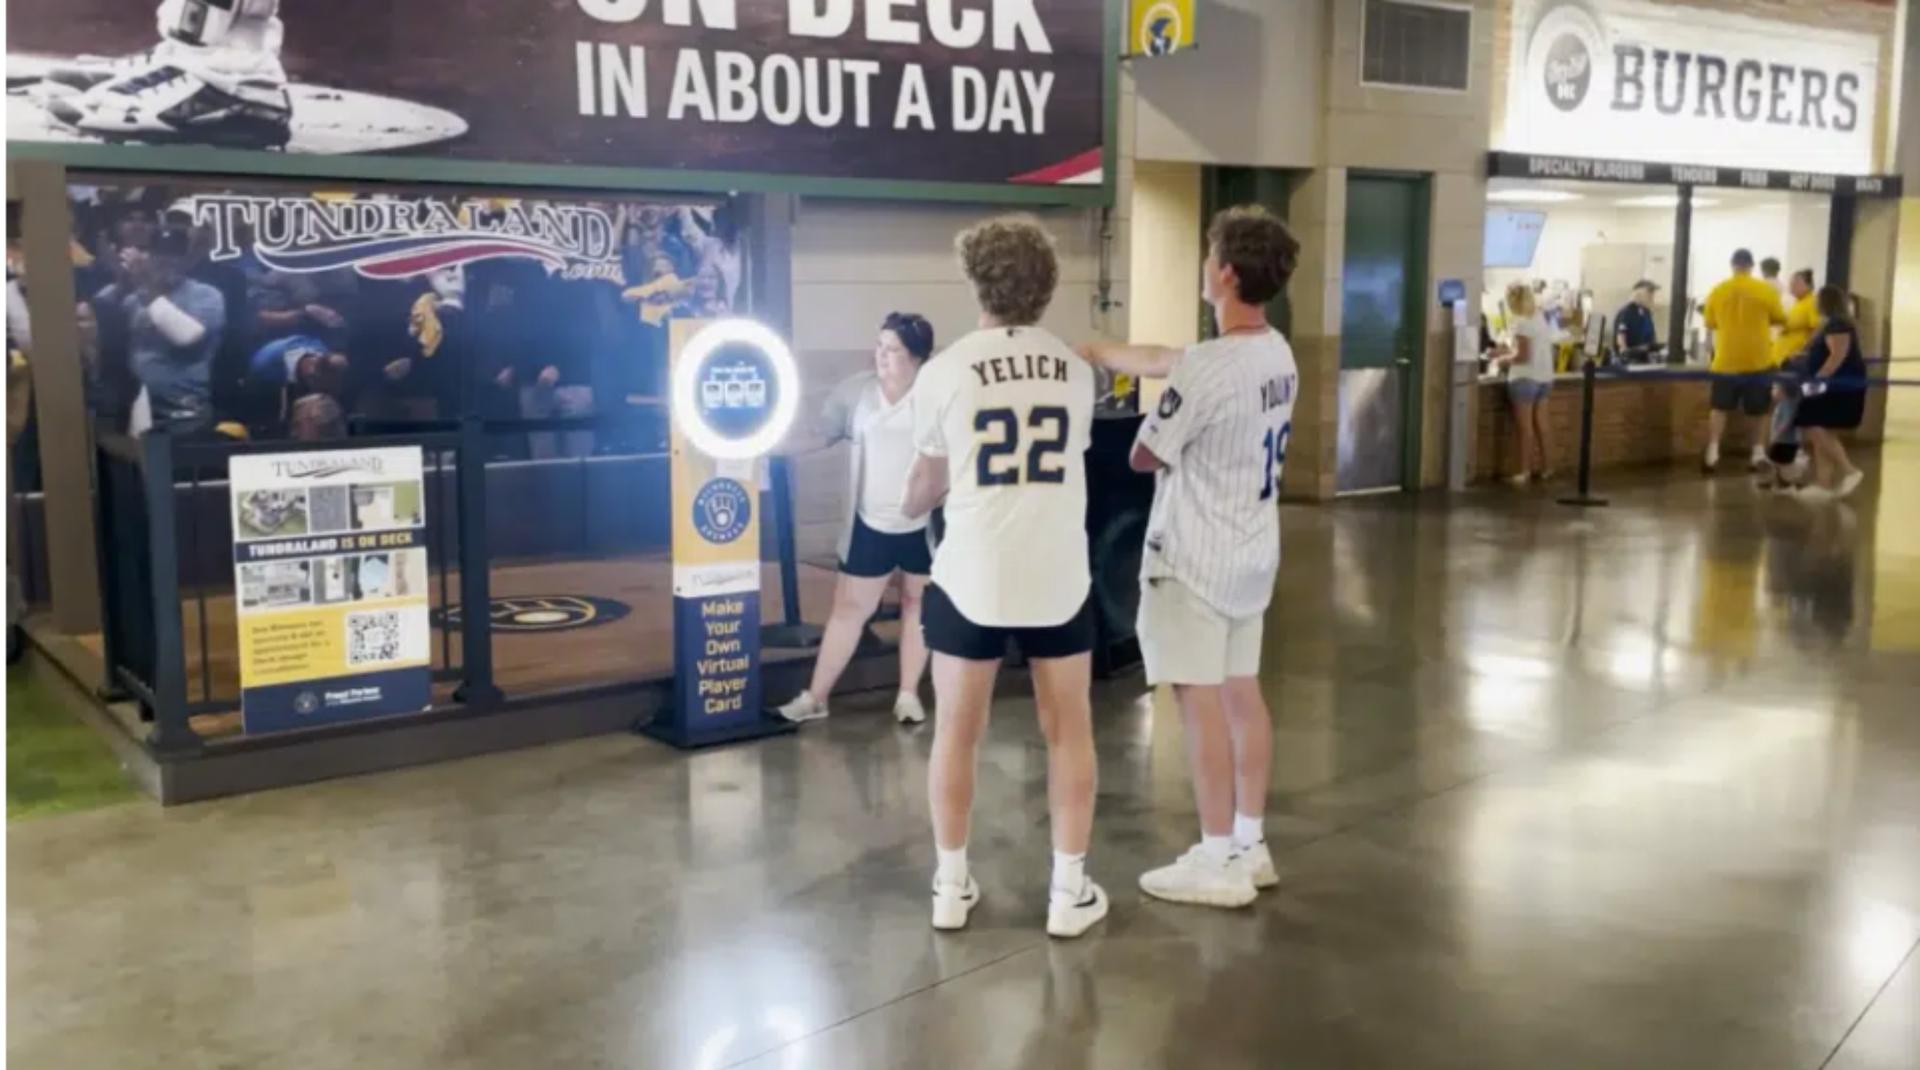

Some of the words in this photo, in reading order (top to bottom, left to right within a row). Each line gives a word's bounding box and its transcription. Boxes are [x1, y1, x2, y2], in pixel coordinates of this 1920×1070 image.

[576, 41, 648, 118] IN
[667, 48, 880, 128] ABOUT
[894, 64, 935, 130] A
[952, 66, 1055, 135] DAY
[1610, 44, 1860, 132] BURGERS
[1529, 156, 1591, 177] SPECIALTY
[1594, 161, 1645, 180] BURGERS
[1671, 165, 1717, 184] TENDERS
[195, 195, 613, 262] TUNDRALAND
[971, 354, 1069, 387] YELICH
[974, 406, 1070, 487] 22
[249, 538, 338, 556] TUNDRALAND
[341, 536, 354, 549] IS
[358, 534, 377, 548] ON
[380, 532, 413, 546] DECK
[702, 601, 744, 617] Make
[706, 620, 741, 635] Your
[706, 640, 740, 655] Own
[697, 655, 749, 674] Virtual
[699, 677, 747, 696] Player
[704, 696, 742, 713] Card
